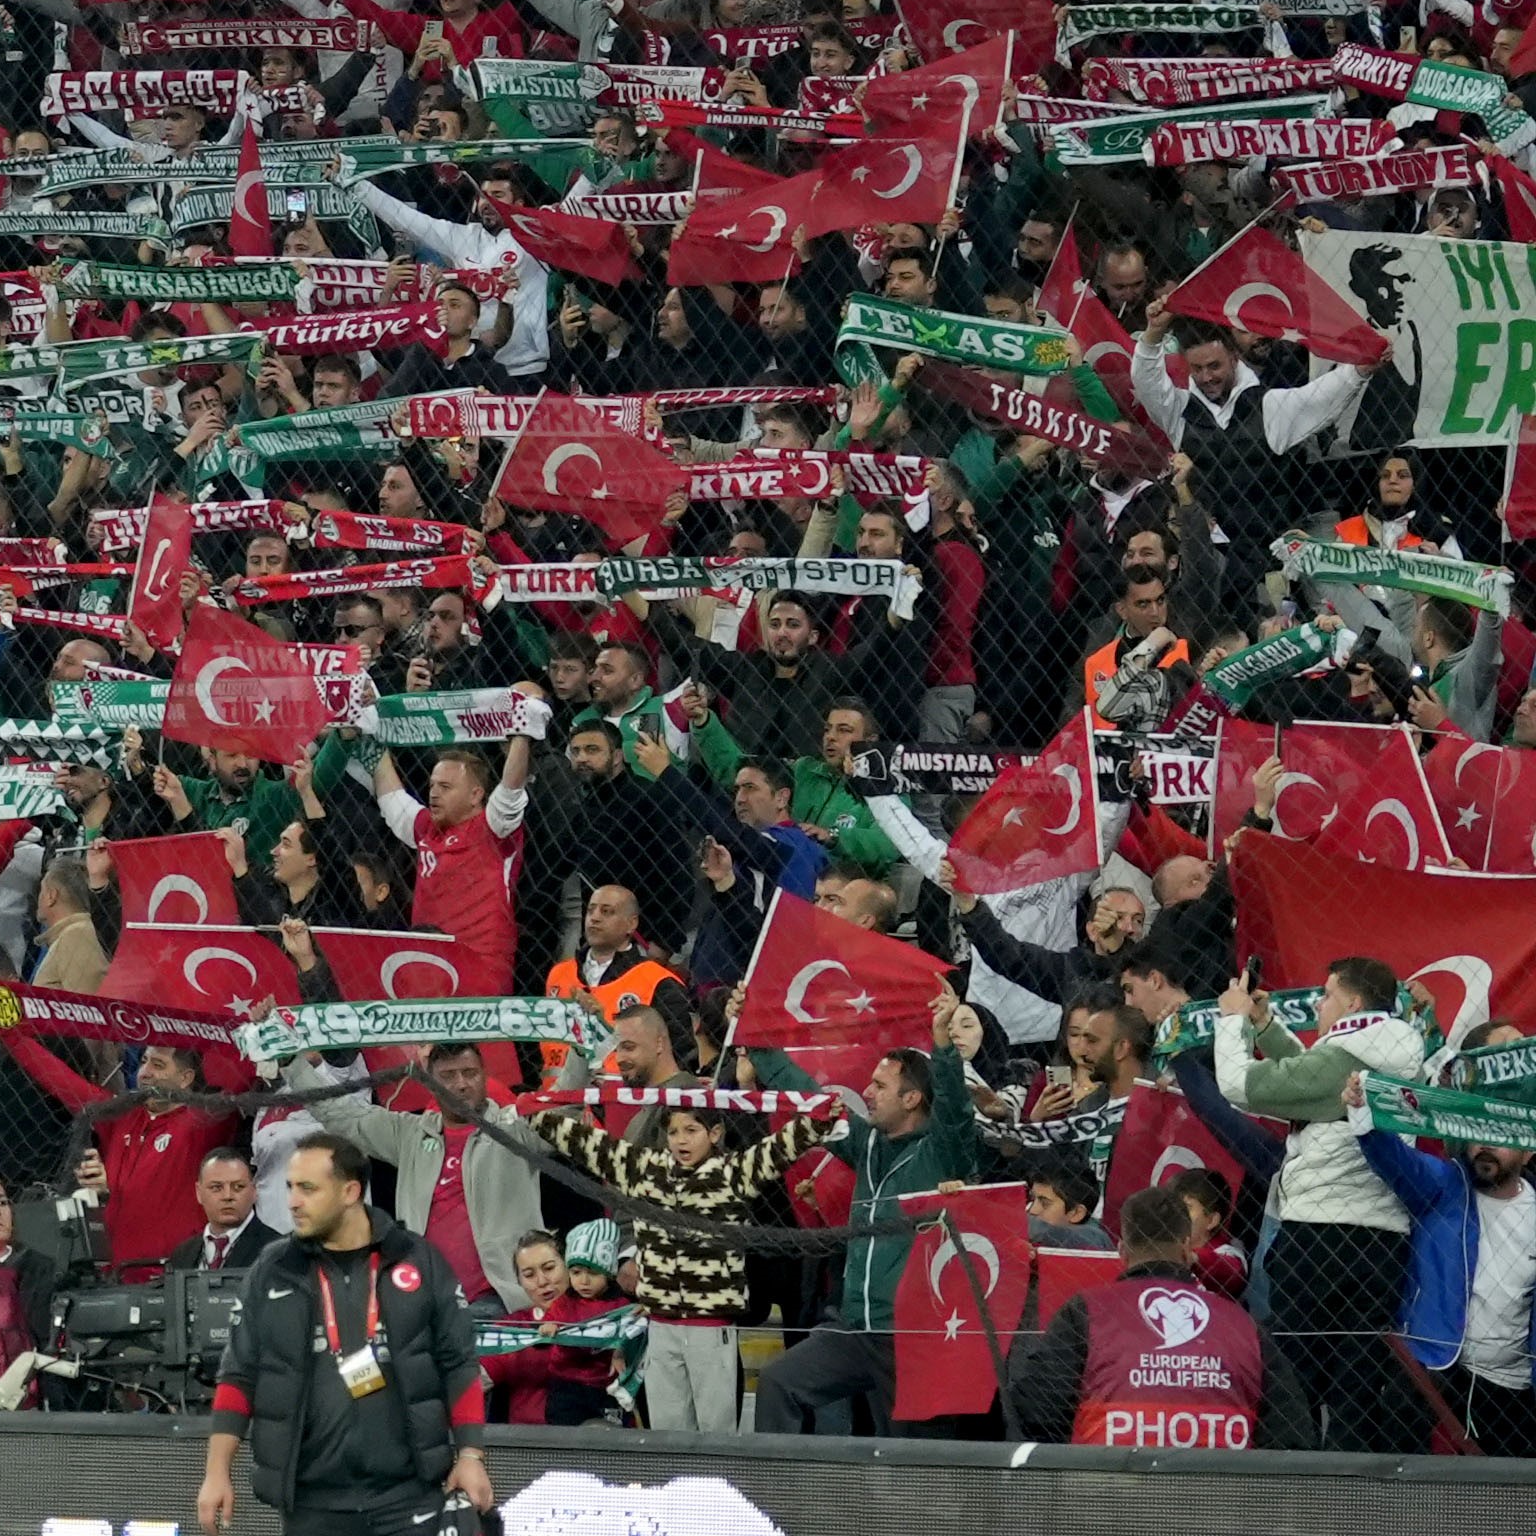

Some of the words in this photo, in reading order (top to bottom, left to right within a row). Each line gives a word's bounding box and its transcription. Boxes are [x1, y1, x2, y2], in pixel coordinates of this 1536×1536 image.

[171, 26, 329, 46] TÜRKİYE
[1341, 52, 1411, 92] TÜRKİYE
[1183, 122, 1367, 158] TÜRKİYE
[1289, 150, 1470, 200] TÜRKİYE
[268, 315, 409, 348] Türkiye
[989, 383, 1111, 455] TÜRKİYE
[1215, 636, 1303, 690] BULGARIA
[904, 753, 994, 772] MUSTAFA
[26, 1000, 48, 1020] BU
[51, 1002, 104, 1025] SEVDA
[299, 1014, 359, 1045] 19
[368, 1008, 492, 1036] Bursaspor
[500, 1002, 565, 1033] 63
[1128, 1370, 1231, 1390] QUALIFIERS
[1139, 1354, 1221, 1370] EUROPEAN
[1105, 1411, 1250, 1448] PHOTO
